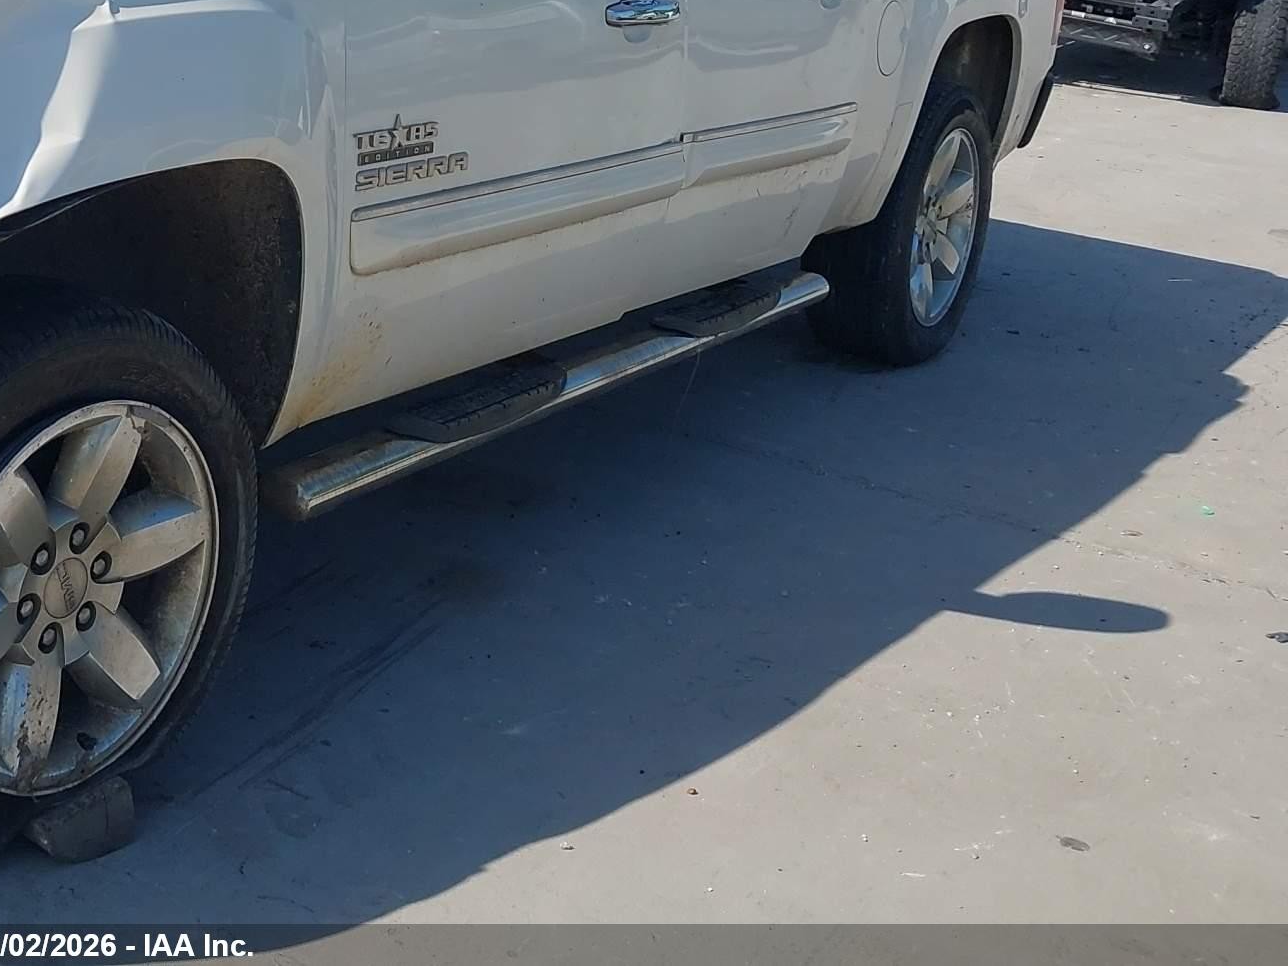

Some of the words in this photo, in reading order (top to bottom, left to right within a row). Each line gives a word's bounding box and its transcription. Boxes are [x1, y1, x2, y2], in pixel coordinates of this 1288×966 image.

[353, 114, 440, 151] TEXAS
[354, 151, 469, 192] SIERRA
[359, 142, 433, 165] EDITION
